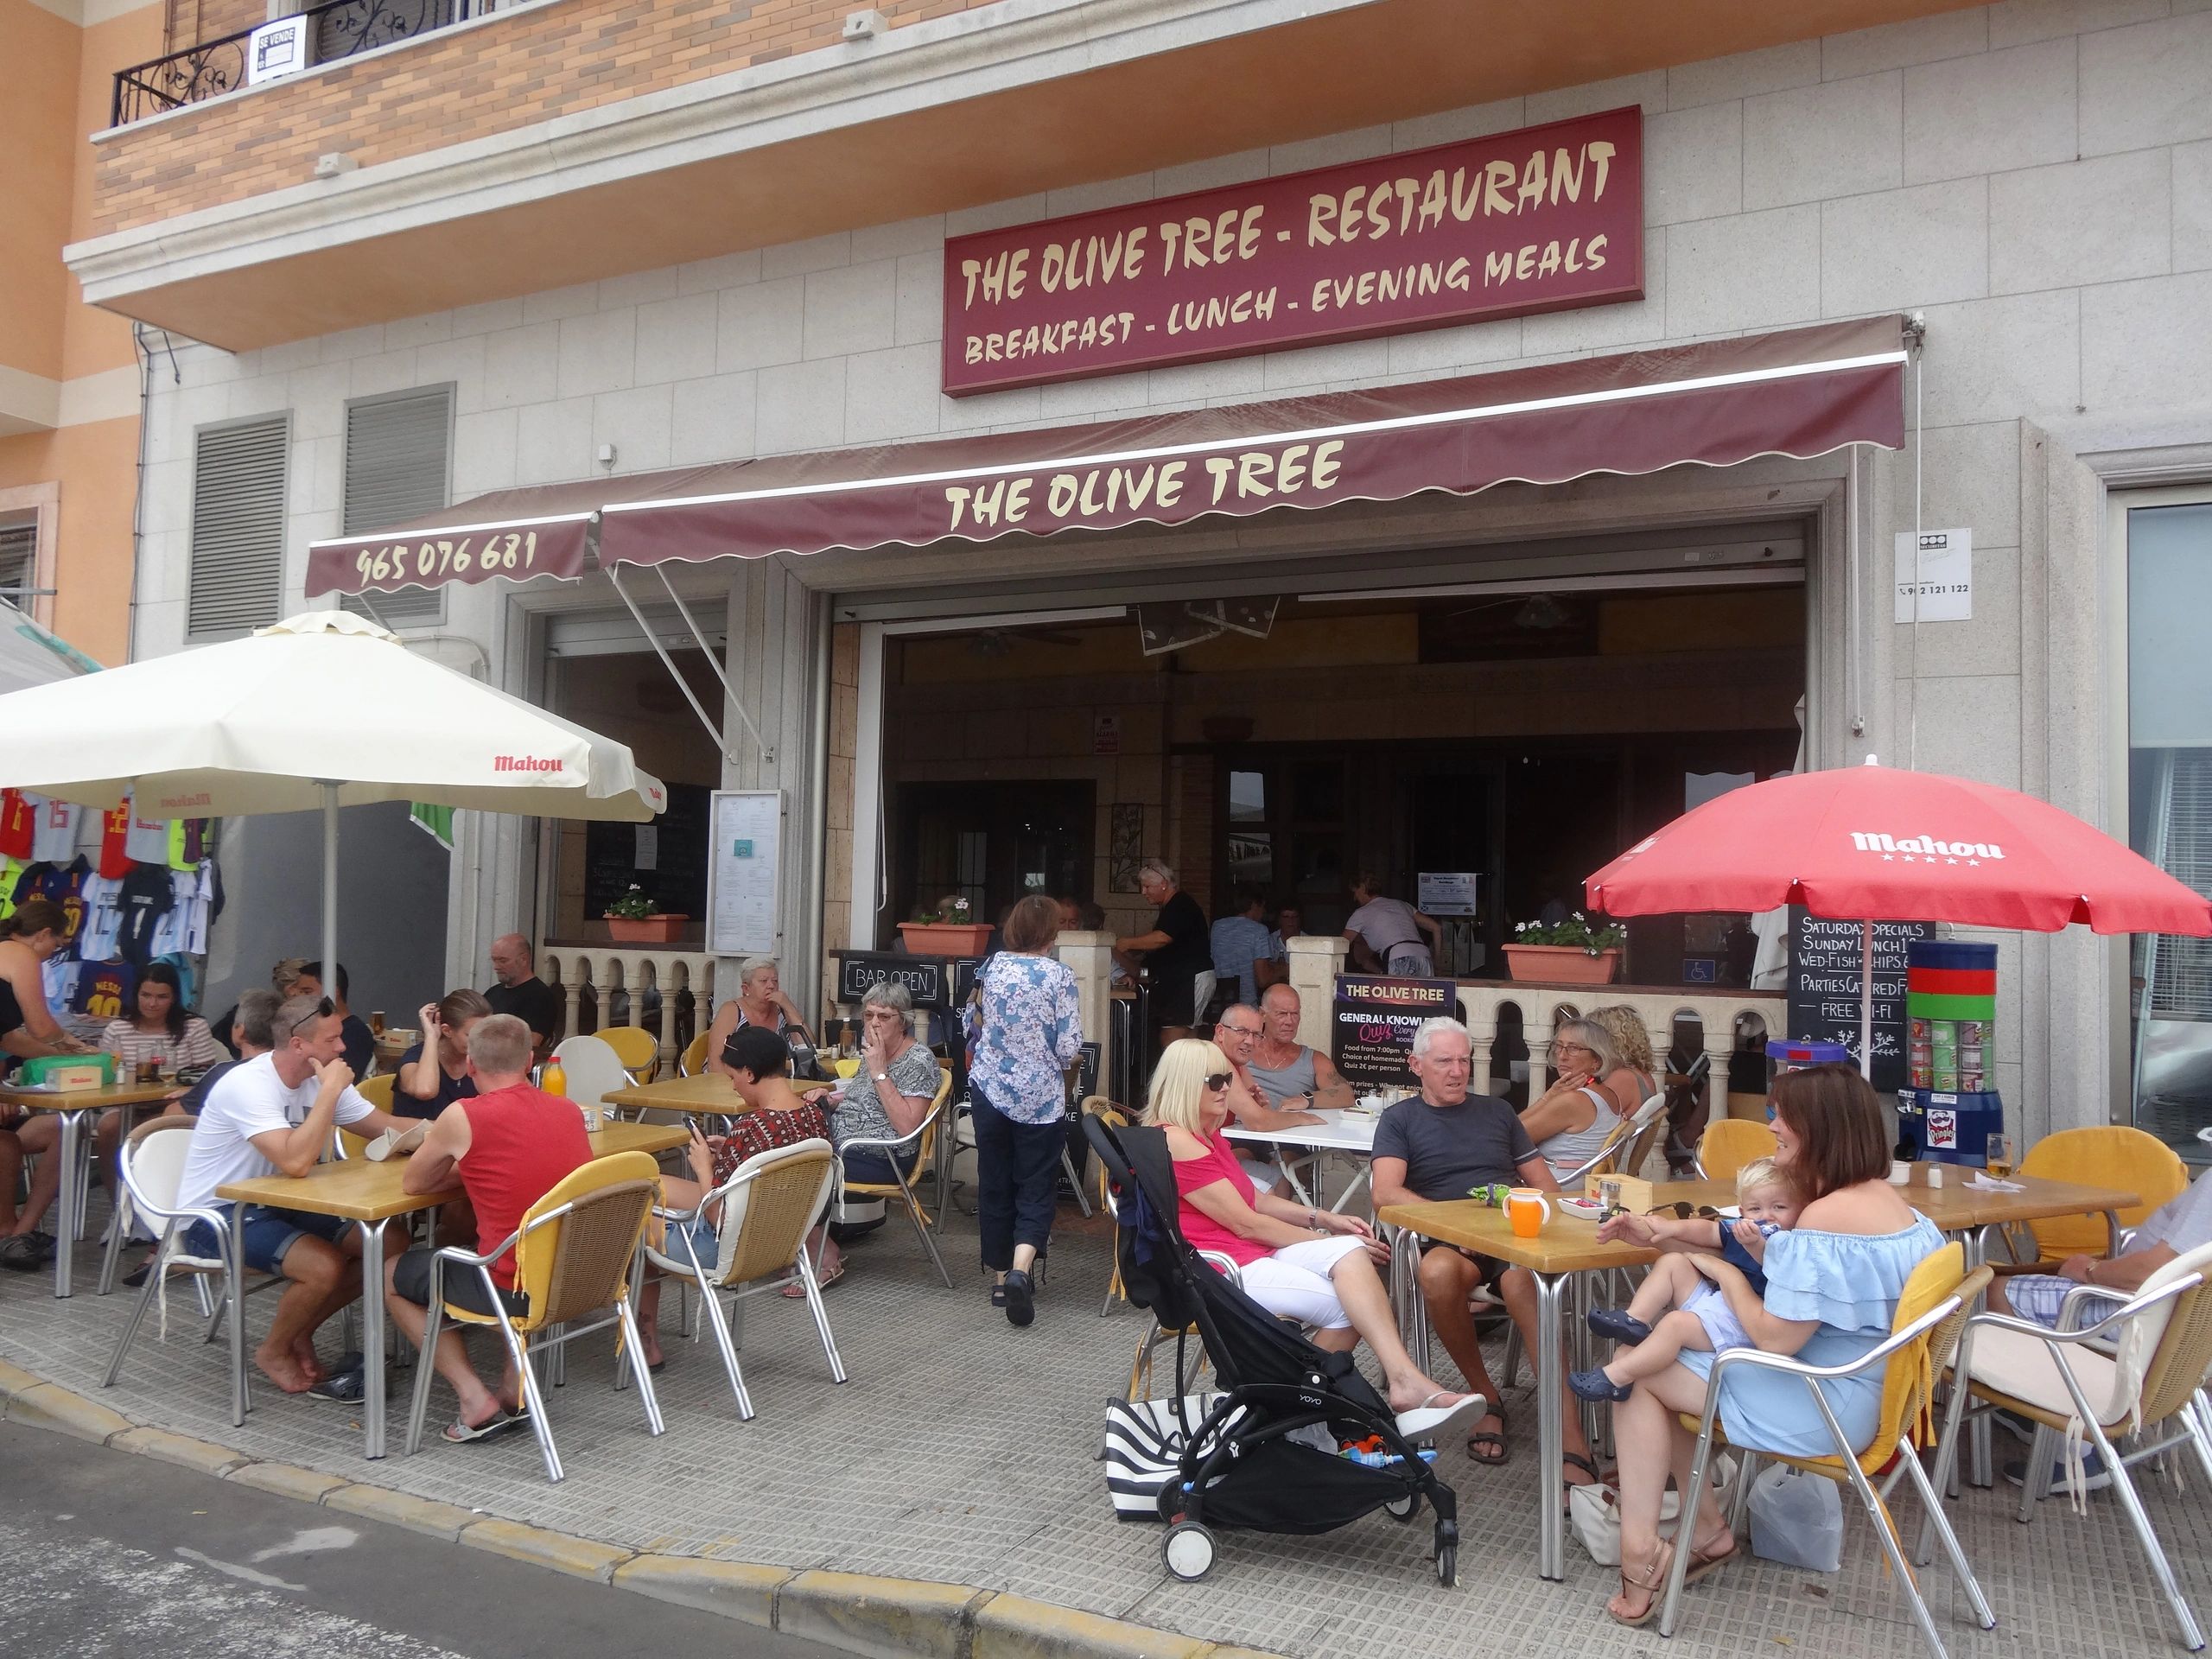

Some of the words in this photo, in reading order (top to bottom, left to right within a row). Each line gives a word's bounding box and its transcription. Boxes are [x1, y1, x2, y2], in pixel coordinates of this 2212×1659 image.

[259, 37, 269, 48] SE
[270, 29, 294, 46] VENDE
[962, 248, 1030, 311] THE
[1040, 226, 1147, 294] OLIVE
[1160, 205, 1264, 277] TREE
[1308, 141, 1617, 248] RESTAURANT
[965, 312, 1135, 365] BREAKFAST
[1166, 286, 1277, 335] LUNCH
[1312, 257, 1471, 313] EVENING
[1484, 233, 1608, 288] MEALS
[944, 477, 1033, 533] THE
[1047, 461, 1189, 518] OLIVE
[1205, 440, 1345, 507] TREE
[355, 544, 410, 589] 965
[416, 537, 474, 577] 076
[480, 530, 538, 571] 681
[1930, 586, 1946, 594] 121
[494, 755, 563, 772] Mahou
[1849, 831, 2006, 860] Mahou
[1802, 935, 1854, 950] SUNDAY
[1858, 937, 1900, 952] LNCH
[1871, 955, 1901, 969] HIPS
[855, 969, 887, 988] BAR
[890, 970, 929, 992] OPEN
[1801, 974, 1846, 993] PARTIES
[1846, 975, 1897, 995] CARED
[1346, 985, 1370, 997] THE
[1371, 986, 1409, 999] OLIVE
[1412, 988, 1444, 1001] TREE
[1339, 1013, 1384, 1024] GENERAL
[1821, 1002, 1855, 1018] FREE
[1859, 1003, 1891, 1019] I-FI
[1359, 1023, 1393, 1043] Quiz
[1371, 1054, 1406, 1064] homemade
[1376, 1046, 1401, 1055] 7:00pm
[1356, 1080, 1375, 1089] prizes
[1299, 1394, 1322, 1406] YOYO
